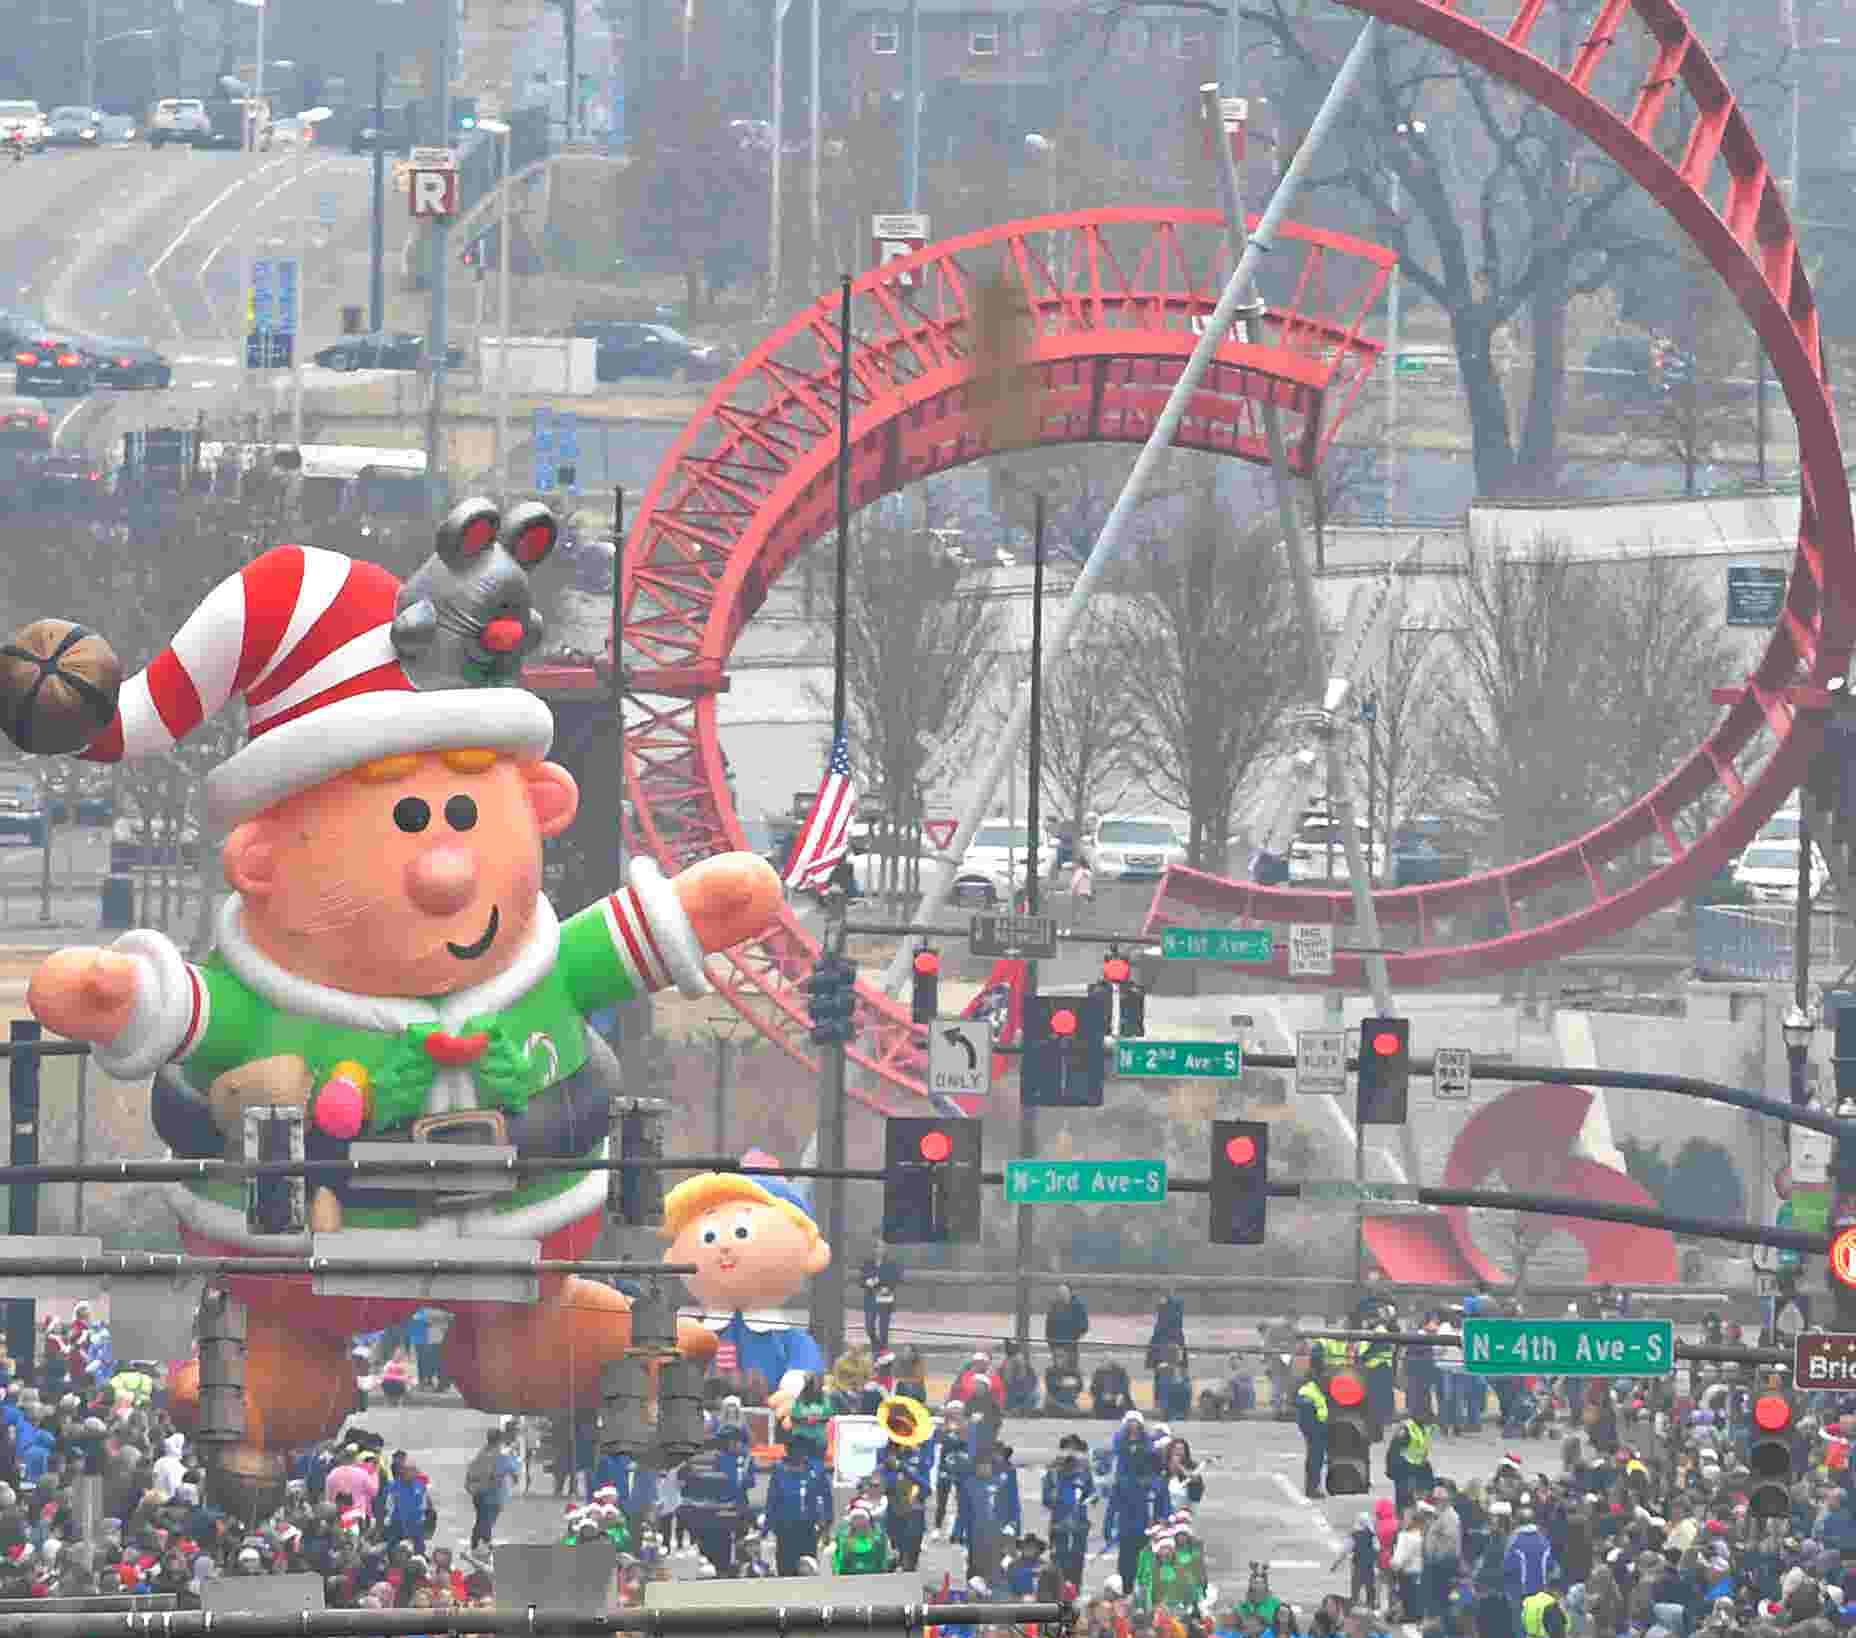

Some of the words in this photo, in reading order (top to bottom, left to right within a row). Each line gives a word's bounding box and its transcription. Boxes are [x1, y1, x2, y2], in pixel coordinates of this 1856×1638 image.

[934, 1072, 983, 1088] ONLY
[1012, 1169, 1080, 1194] N-3rd
[1091, 1167, 1161, 1193] Ave-S
[1472, 1330, 1557, 1360] N-4th
[1575, 1329, 1664, 1360] Ave-S
